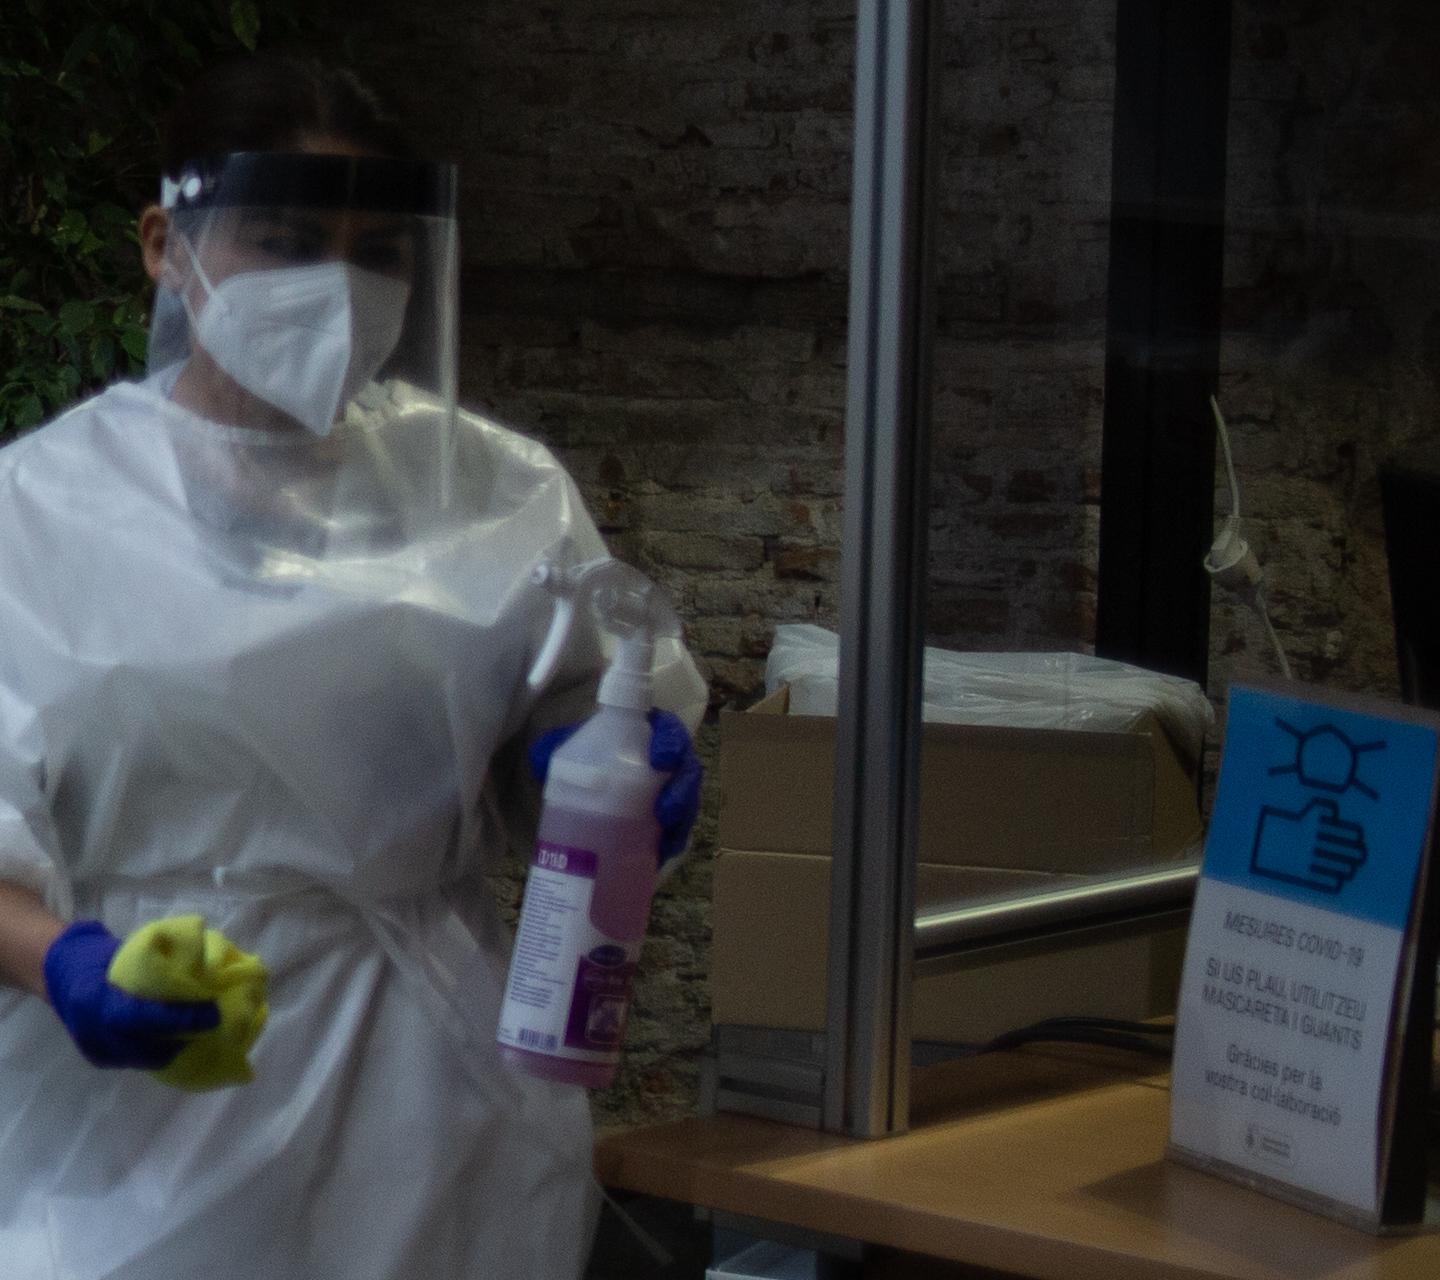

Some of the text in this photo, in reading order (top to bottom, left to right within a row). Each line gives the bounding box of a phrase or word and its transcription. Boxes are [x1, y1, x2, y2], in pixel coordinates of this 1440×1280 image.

[1224, 911, 1365, 967] MESURES COVID-19
[1202, 984, 1289, 1025] MASCARETA
[1301, 1014, 1363, 1051] GUANTS
[1207, 957, 1221, 978] SI
[1224, 962, 1244, 985] US
[1291, 981, 1368, 1022] UTILITZEU
[1205, 1070, 1249, 1096] vostra
[1282, 1066, 1307, 1086] per
[1310, 1070, 1323, 1092] la
